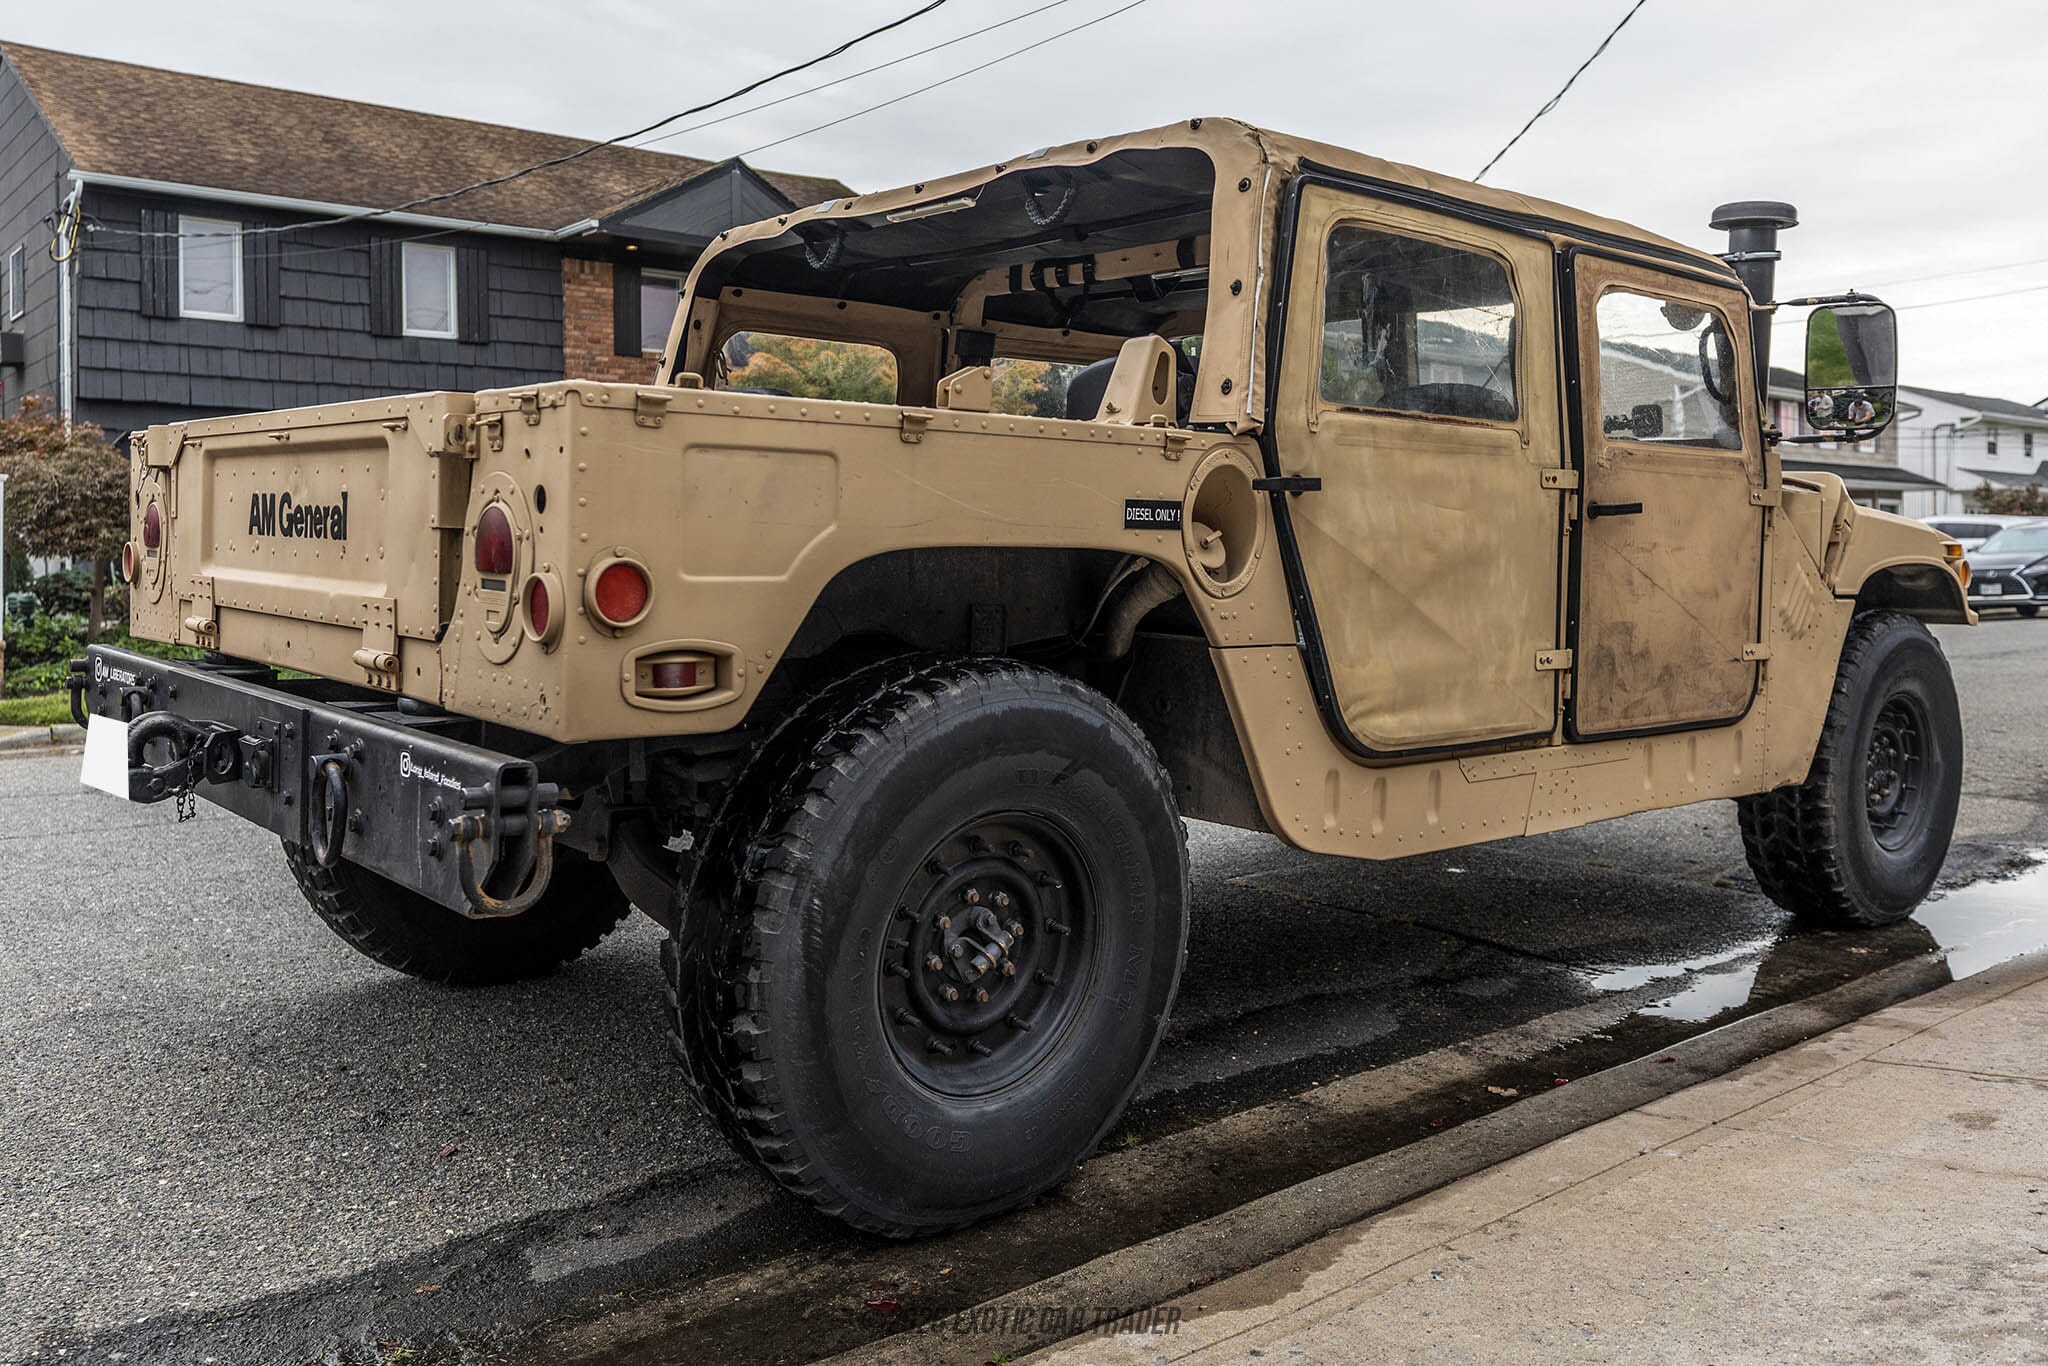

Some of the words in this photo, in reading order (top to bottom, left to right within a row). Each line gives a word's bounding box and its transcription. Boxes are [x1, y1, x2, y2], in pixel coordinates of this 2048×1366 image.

[248, 492, 276, 537] AM
[279, 491, 349, 541] General
[1126, 507, 1154, 521] DIESEL
